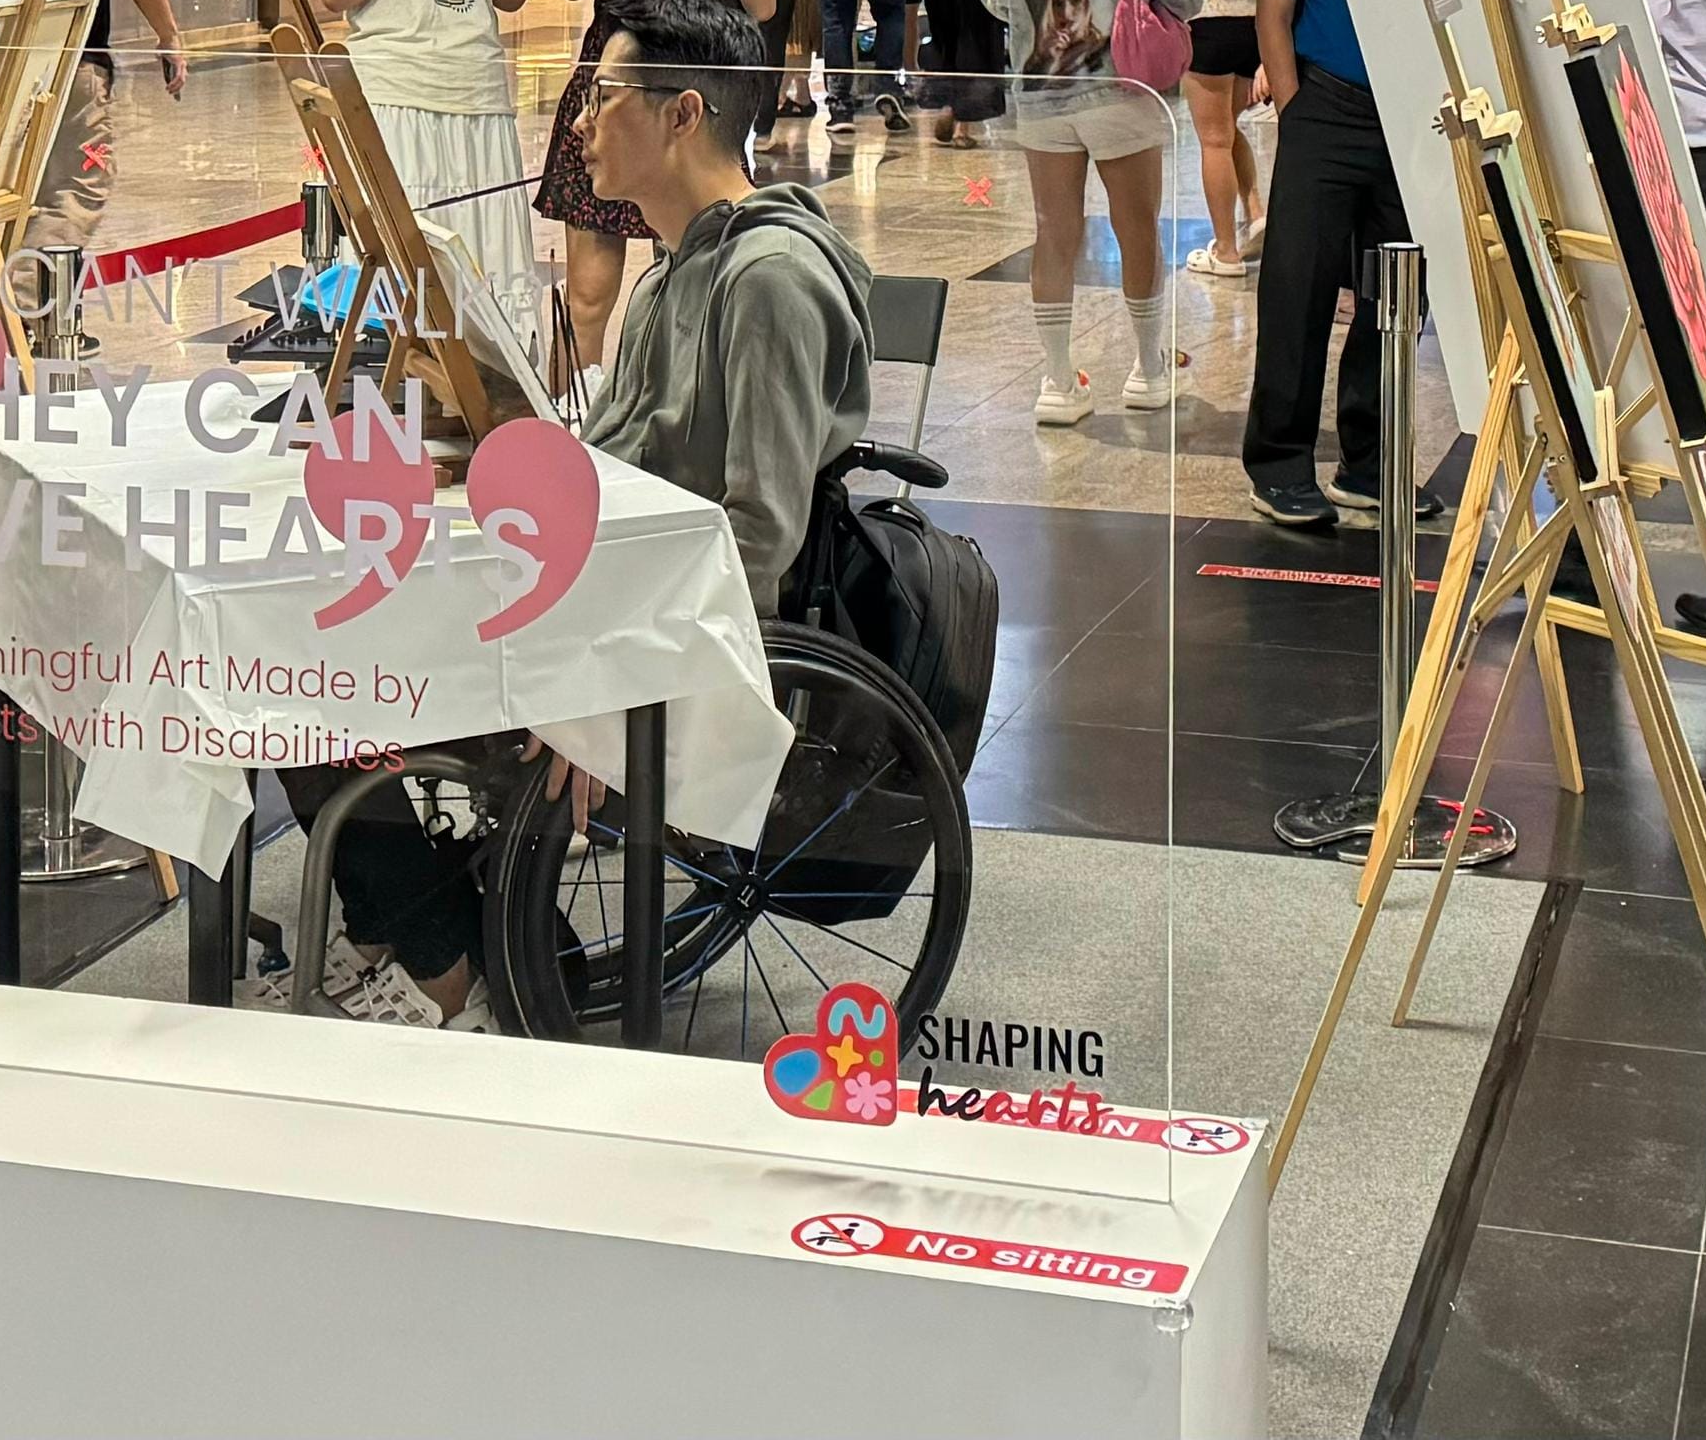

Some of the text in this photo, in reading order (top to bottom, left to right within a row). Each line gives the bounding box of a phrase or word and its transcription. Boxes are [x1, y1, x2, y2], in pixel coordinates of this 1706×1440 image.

[186, 368, 425, 467] CAN
[124, 481, 542, 598] HEARTS
[149, 649, 209, 690] Art
[225, 656, 356, 701] Made
[376, 663, 429, 718] by
[52, 704, 145, 751] with
[161, 714, 406, 774] Disabilities
[917, 1012, 1105, 1078] SHAPING
[917, 1066, 1114, 1134] hearts
[906, 1234, 1157, 1288] No sitting
